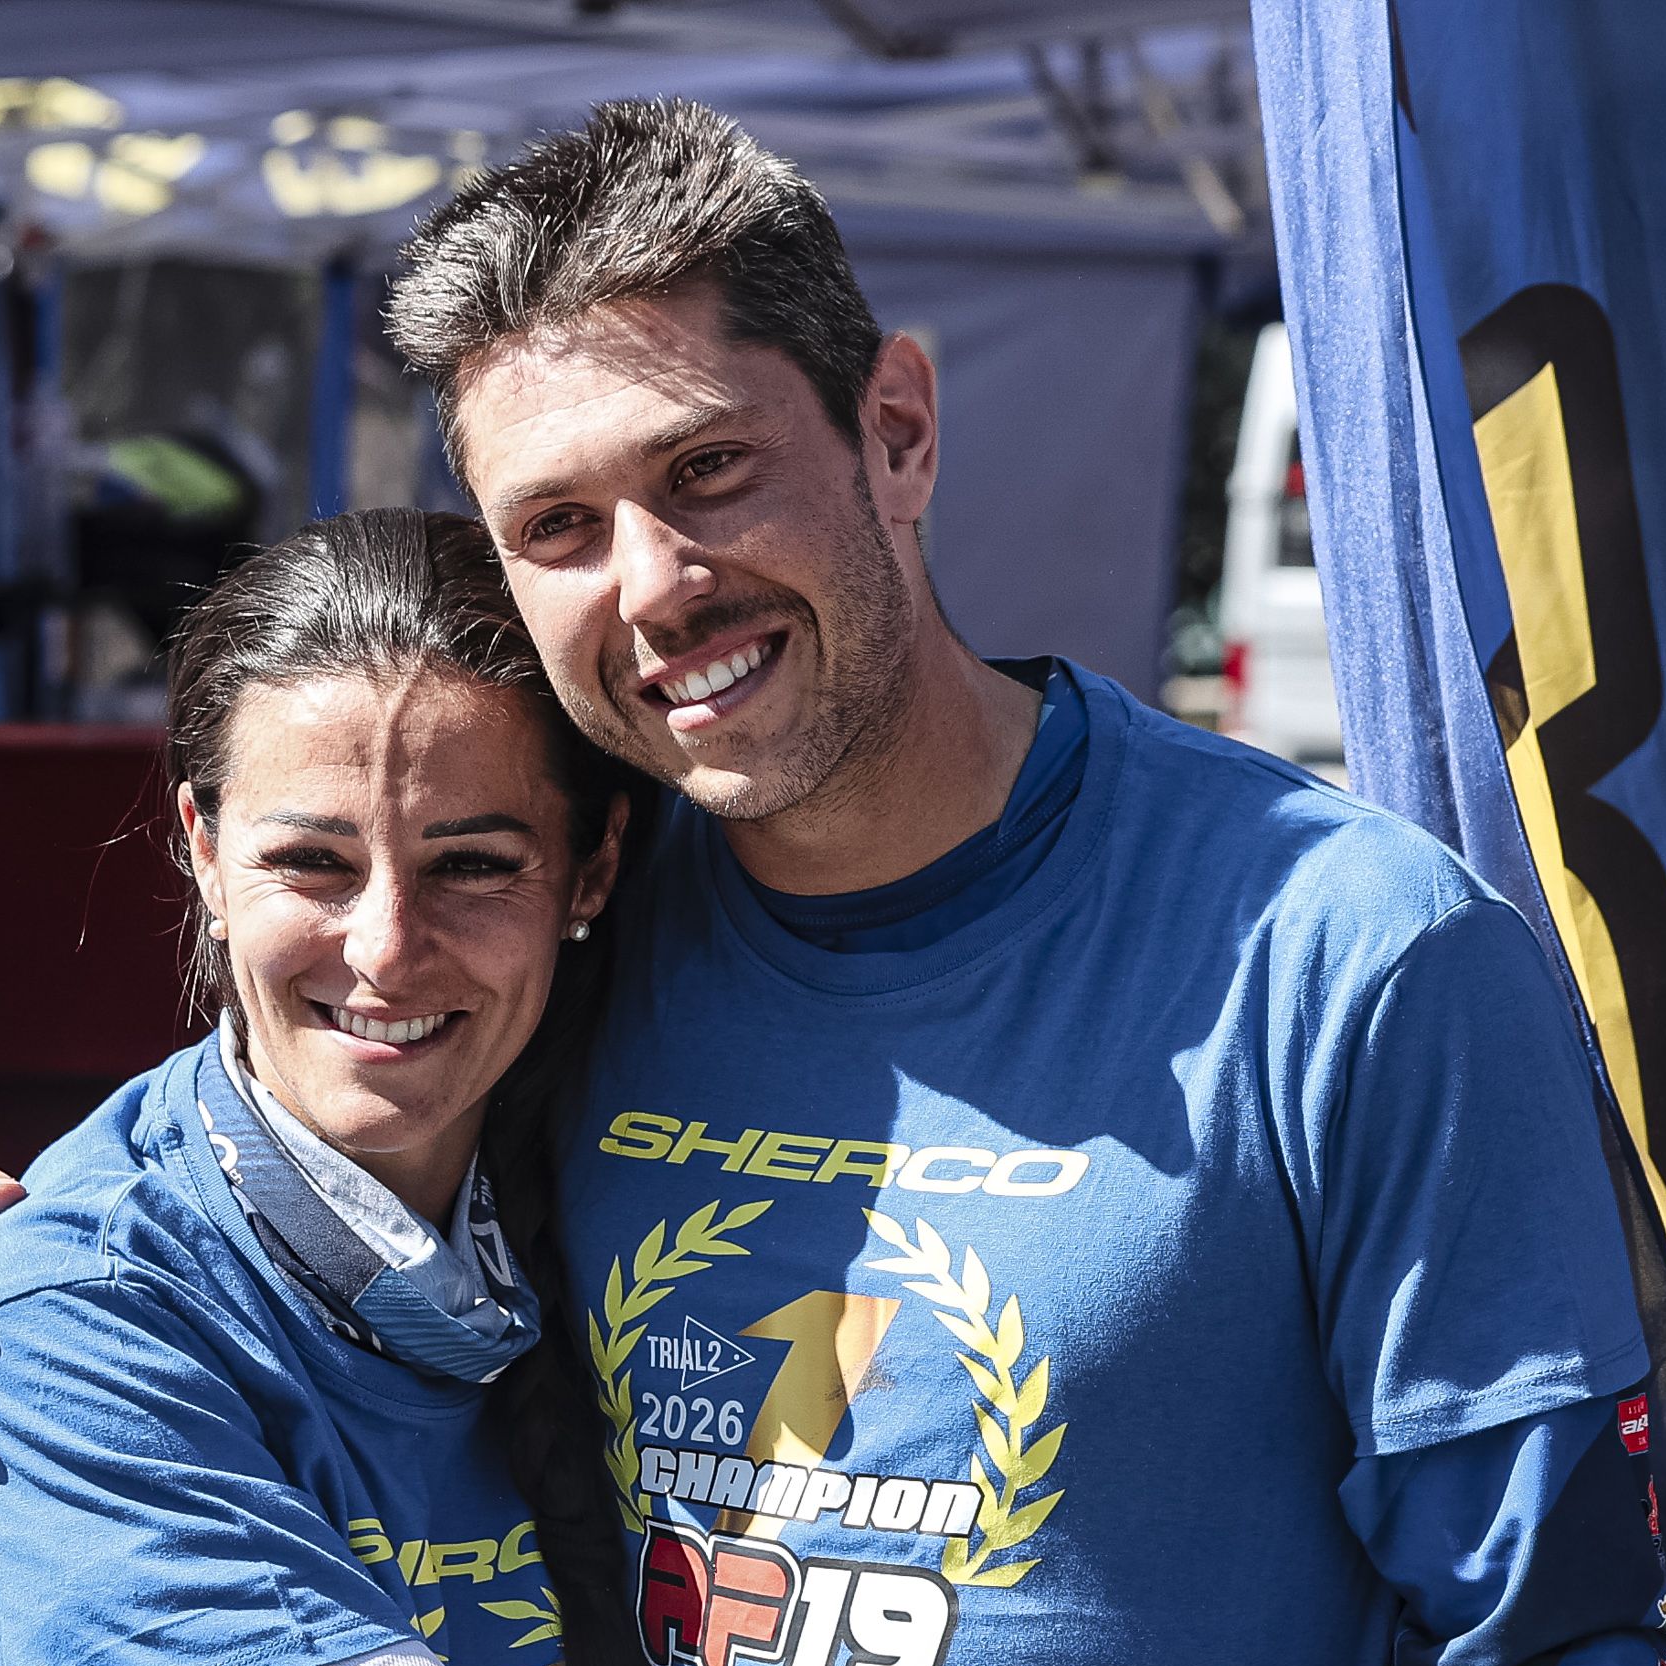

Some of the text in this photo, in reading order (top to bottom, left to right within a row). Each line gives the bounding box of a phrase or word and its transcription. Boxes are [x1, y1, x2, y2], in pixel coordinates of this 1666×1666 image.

[599, 1111, 1090, 1197] SHERCO
[639, 1391, 744, 1446] 2026
[639, 1447, 984, 1537] CHAMPION
